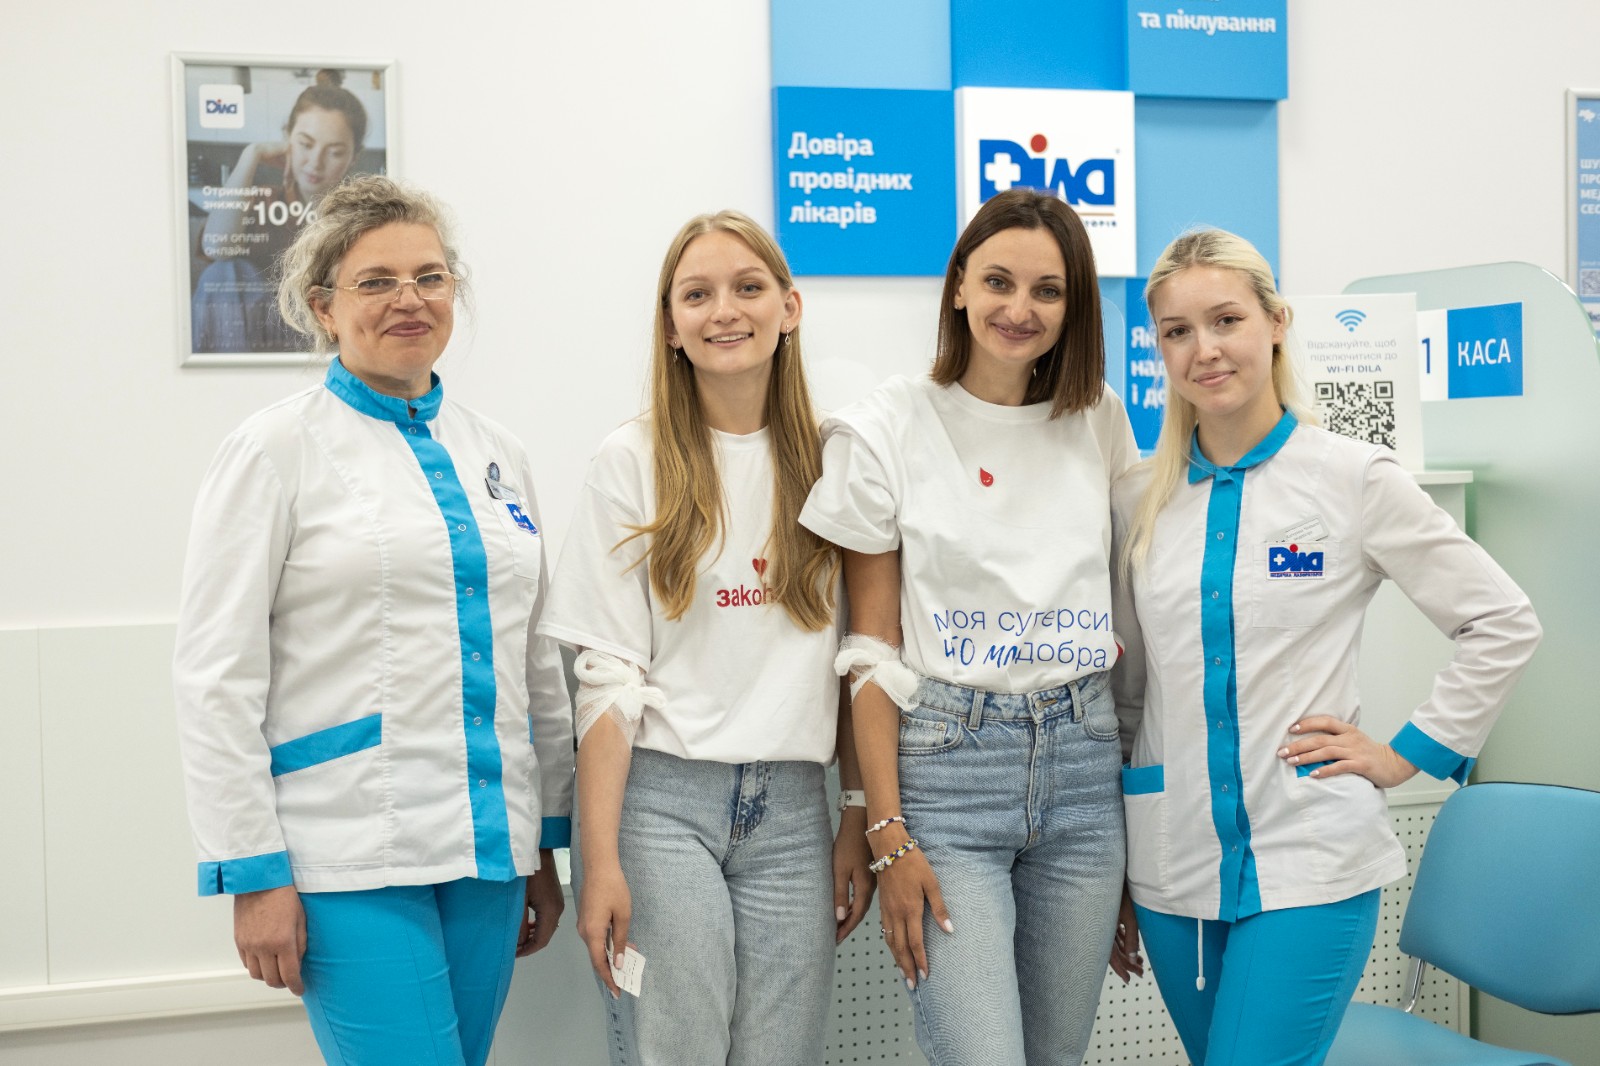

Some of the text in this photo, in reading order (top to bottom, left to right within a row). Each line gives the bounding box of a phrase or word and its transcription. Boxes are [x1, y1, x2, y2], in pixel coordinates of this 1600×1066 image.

[1138, 9, 1276, 36] та піклування
[788, 132, 874, 162] Довіра
[1580, 158, 1600, 169] ШУ
[789, 166, 912, 193] провідних
[202, 185, 272, 198] Отримайте
[202, 200, 250, 212] знижку
[253, 201, 318, 226] 10%
[788, 201, 877, 229] лікарів
[203, 233, 269, 243] при оплаті
[204, 245, 250, 256] онлайн
[1307, 338, 1397, 351] Відскануйте, щоб
[1310, 351, 1398, 363] підключитися до
[1457, 337, 1511, 367] КАСА
[1326, 364, 1382, 374] WI-FI DILA
[1014, 639, 1107, 671] добра
